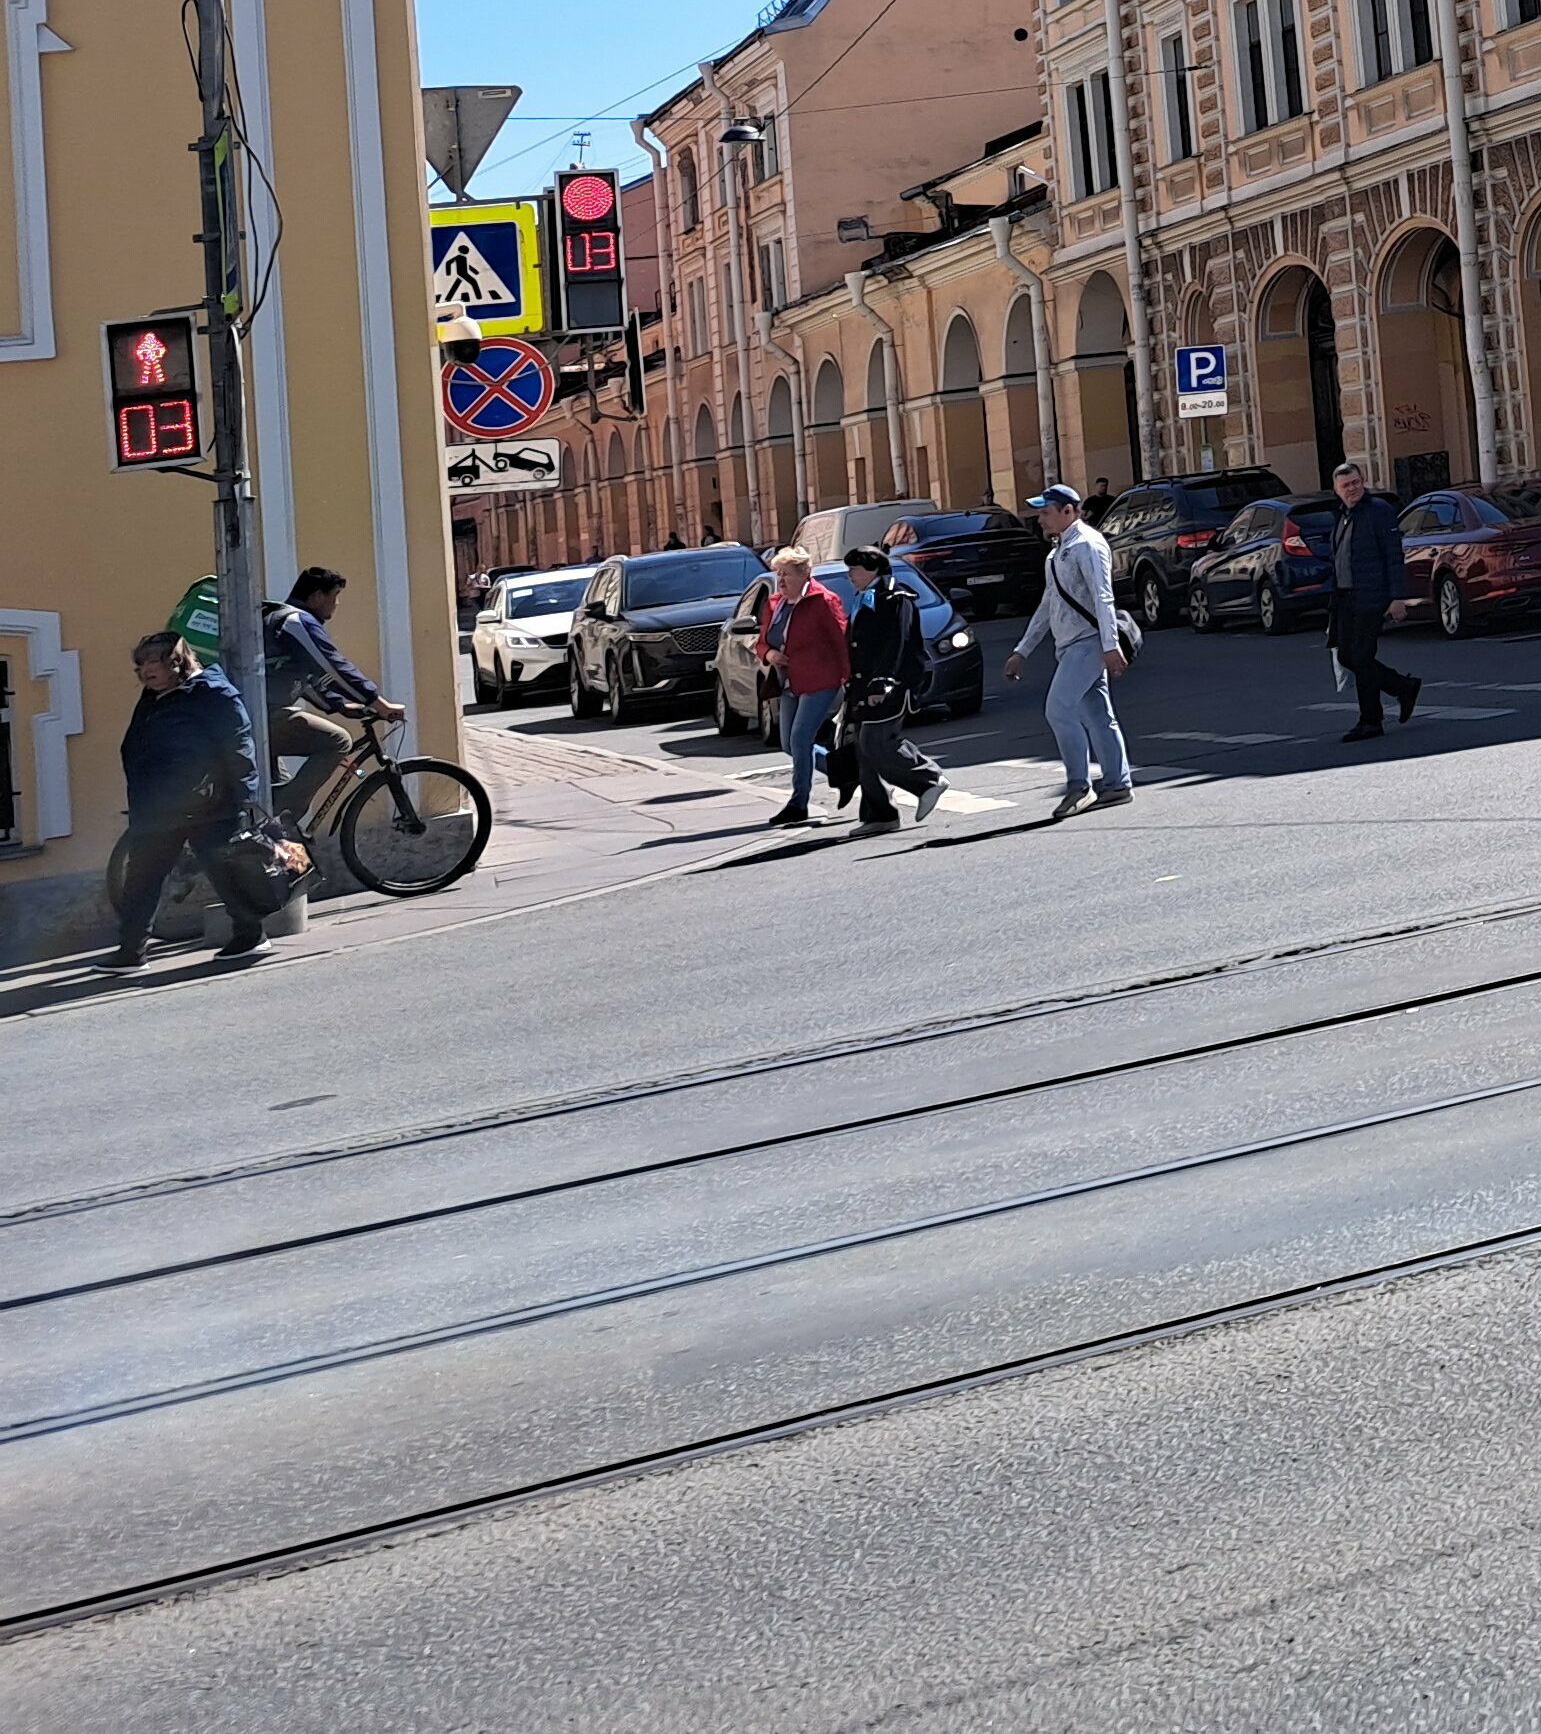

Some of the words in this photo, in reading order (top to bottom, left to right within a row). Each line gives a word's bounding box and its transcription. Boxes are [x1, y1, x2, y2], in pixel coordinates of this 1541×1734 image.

[566, 231, 615, 270] 03
[1190, 351, 1217, 388] P
[120, 398, 194, 458] 03
